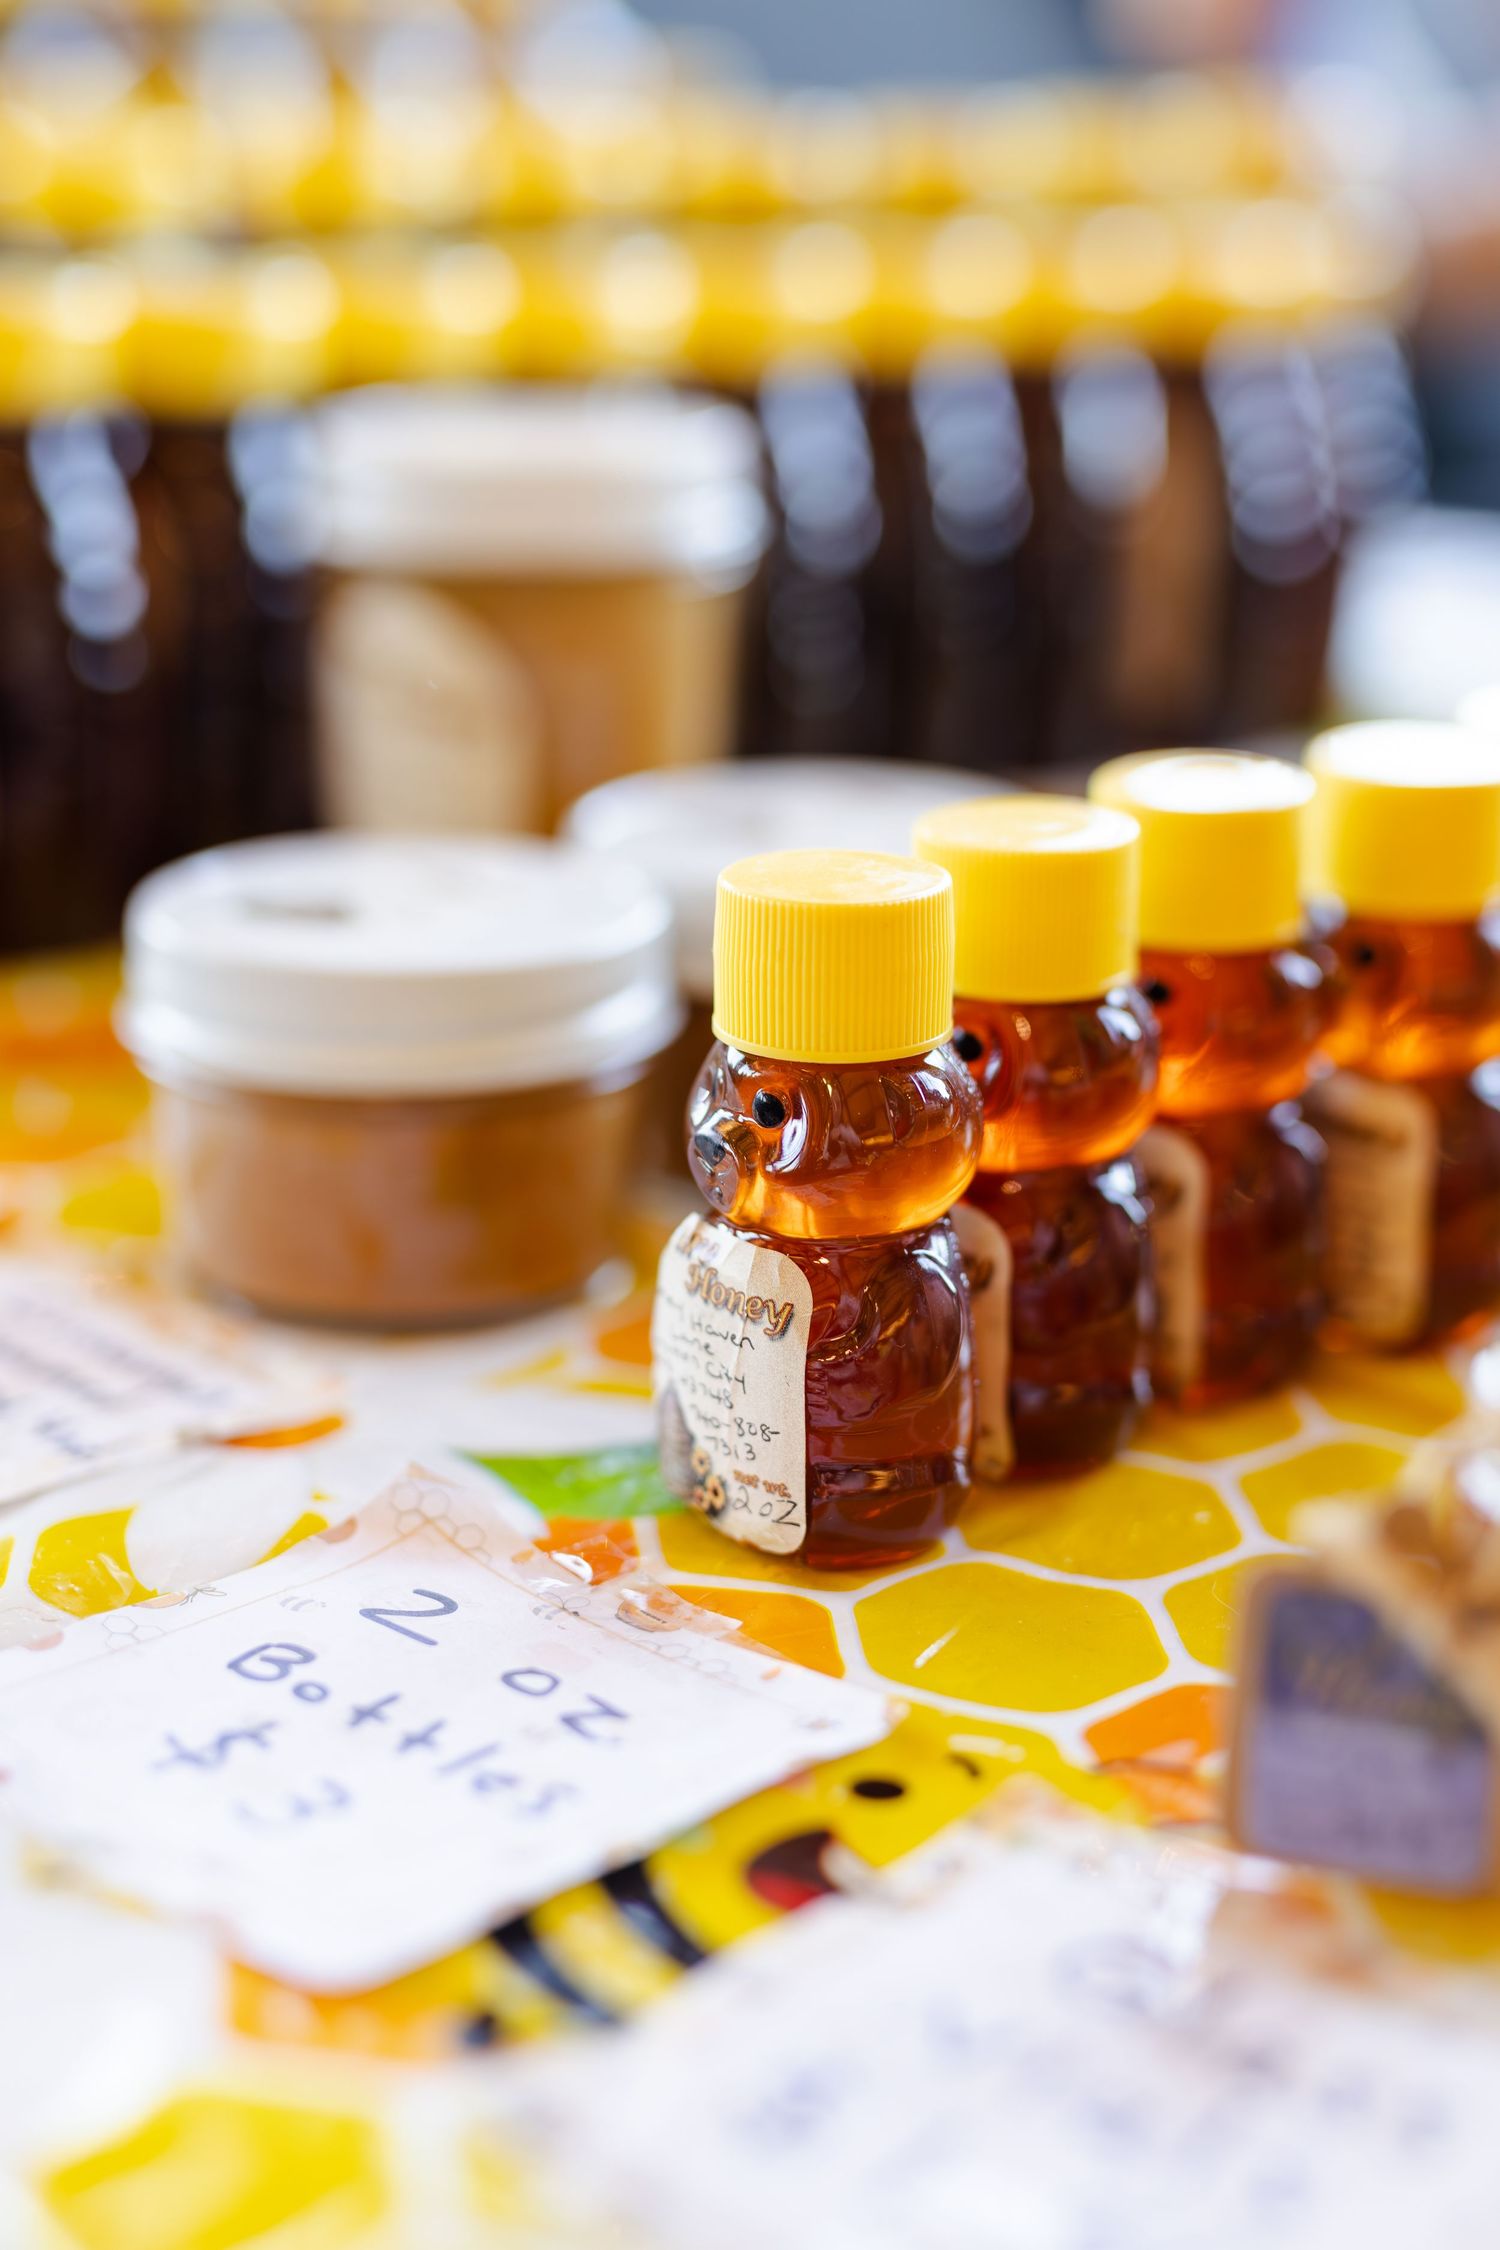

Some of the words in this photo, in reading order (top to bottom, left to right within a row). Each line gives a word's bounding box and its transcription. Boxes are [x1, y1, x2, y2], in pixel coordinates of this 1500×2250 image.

[685, 1263, 794, 1338] Honey
[690, 1314, 755, 1351] Haven
[705, 1360, 747, 1396] City
[704, 1434, 757, 1462] 7313
[359, 1588, 459, 1646] 2
[226, 1641, 578, 1818] Bottles
